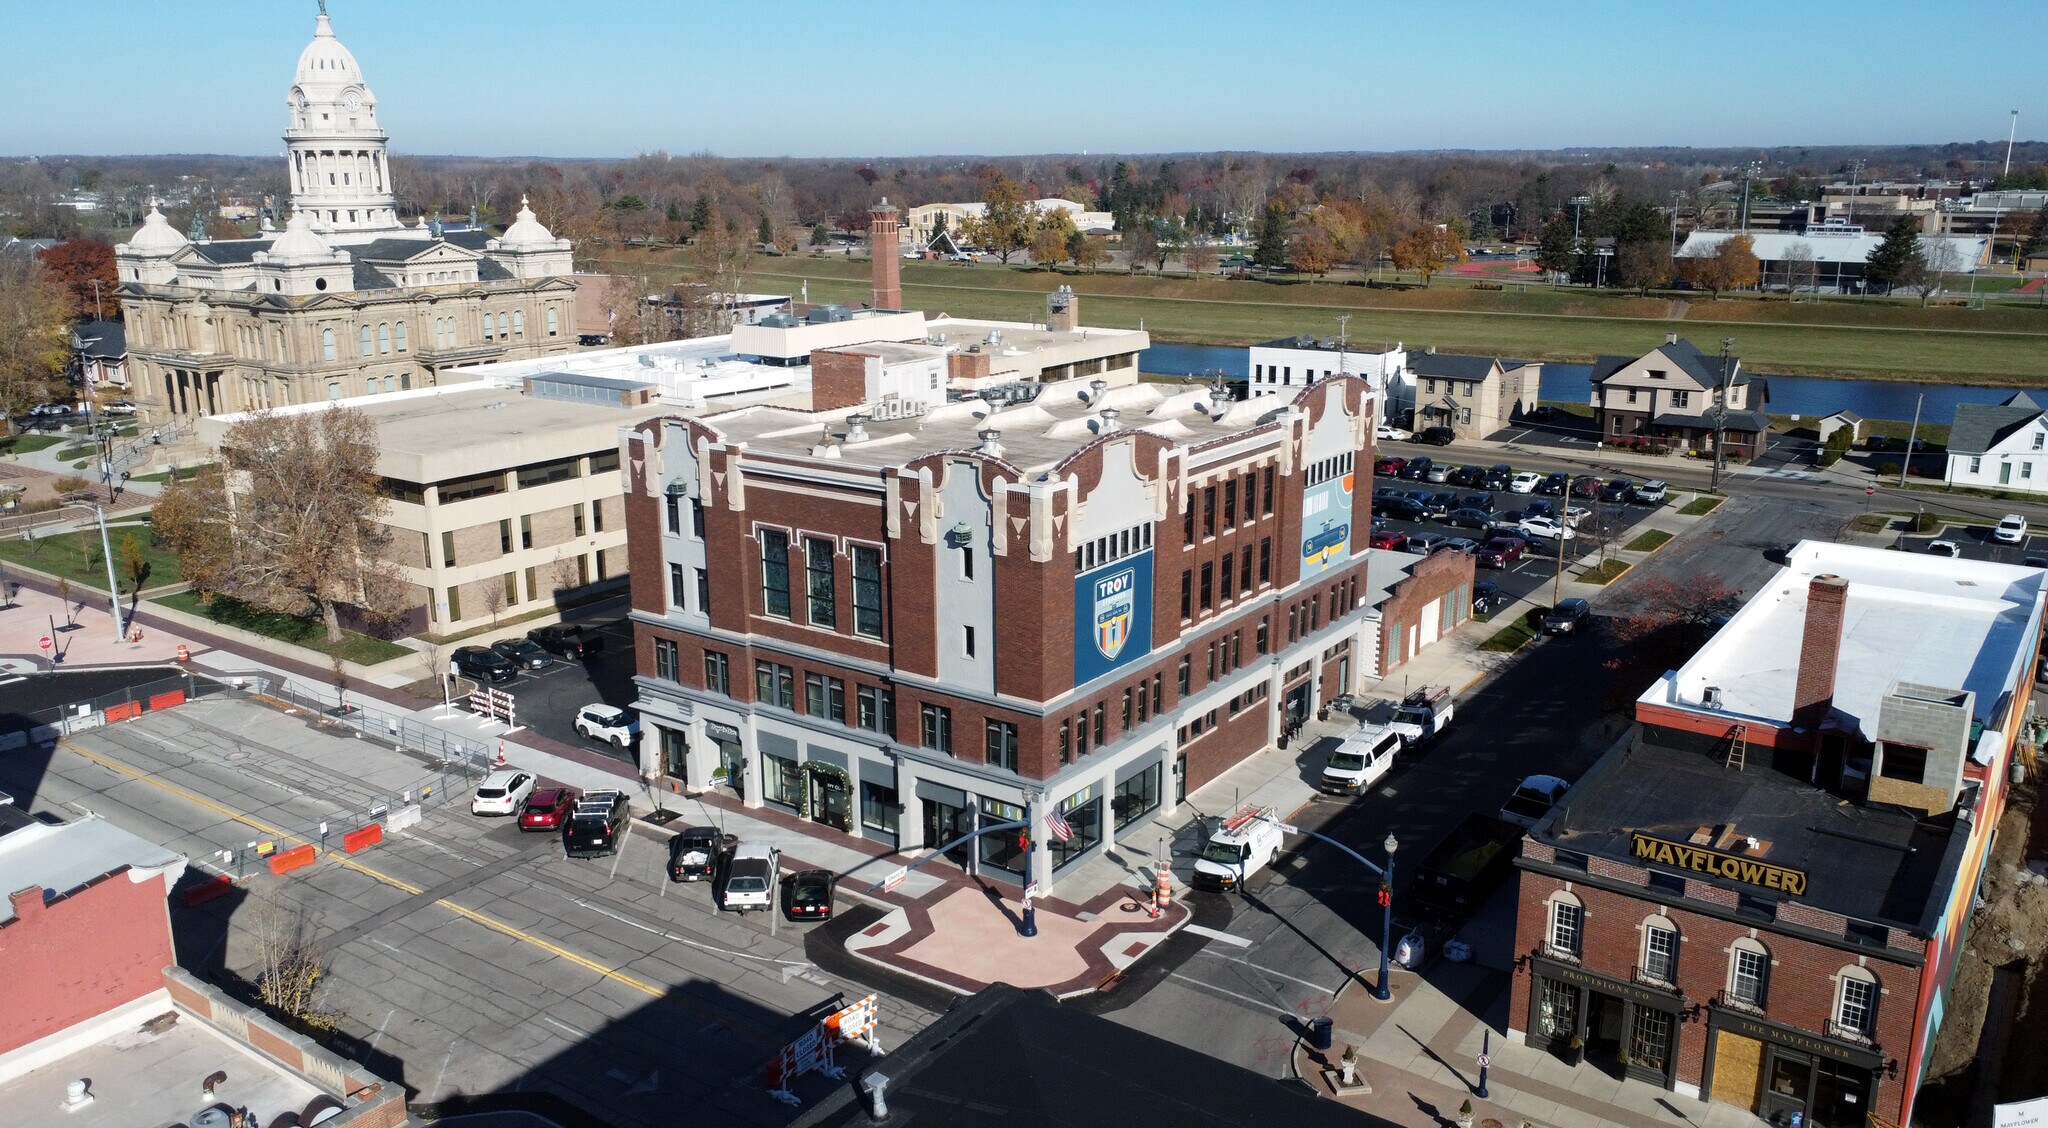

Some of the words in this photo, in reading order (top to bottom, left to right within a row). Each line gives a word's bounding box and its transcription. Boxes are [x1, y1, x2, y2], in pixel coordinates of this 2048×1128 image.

[1100, 574, 1129, 597] TROY
[985, 799, 1023, 821] MISO
[1064, 786, 1091, 813] MISO
[1636, 837, 1800, 894] MAYFLOWER
[1562, 970, 1629, 994] PROVISIONS
[1634, 990, 1652, 1000] CO.
[841, 1018, 863, 1034] CLOSED
[843, 1012, 860, 1026] ROAD
[796, 1039, 817, 1057] CLOSED
[798, 1033, 814, 1047] ROAD
[1742, 1022, 1765, 1034] THE
[1770, 1030, 1850, 1058] MAYFLOWER
[2000, 1117, 2039, 1128] MAYFLOWER
